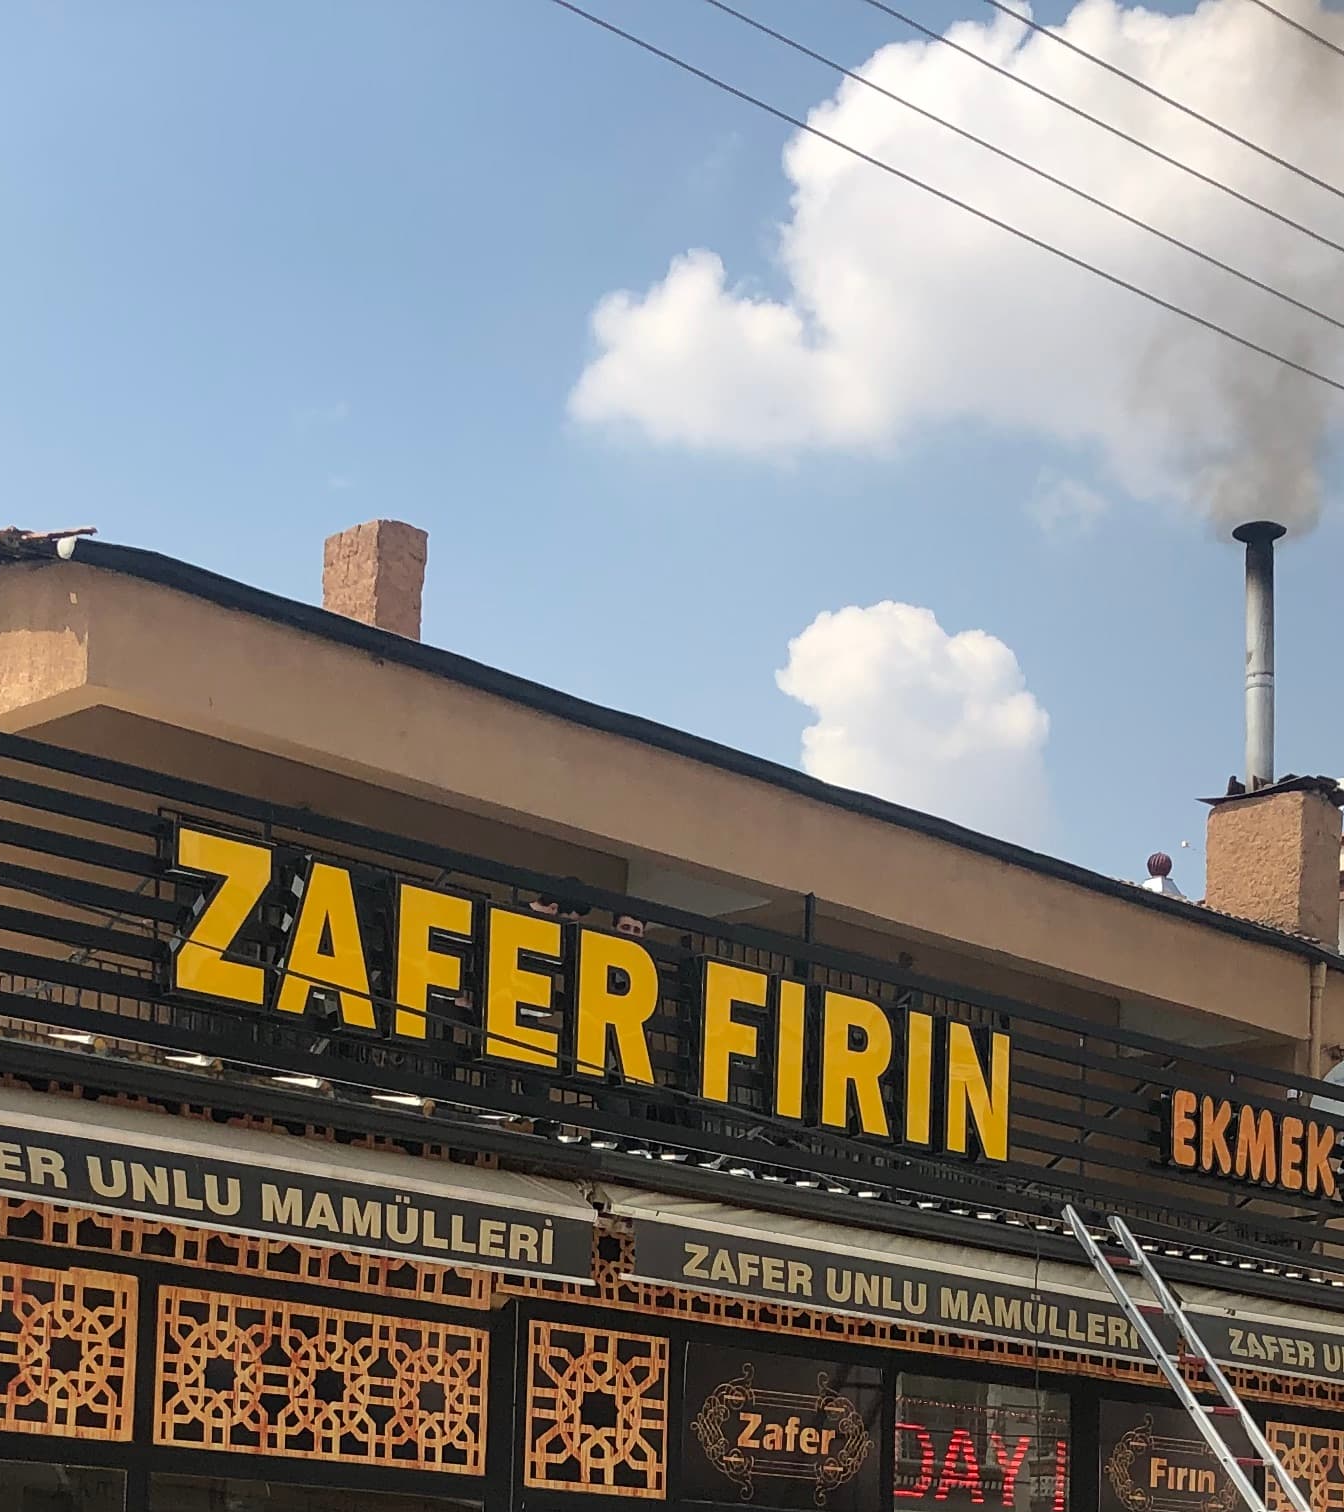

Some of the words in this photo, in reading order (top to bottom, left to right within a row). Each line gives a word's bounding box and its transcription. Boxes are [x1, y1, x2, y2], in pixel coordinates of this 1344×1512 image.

[175, 827, 655, 1086] ZAFER
[702, 960, 1011, 1162] FIRIN
[1172, 1090, 1336, 1198] EKMEK
[87, 1155, 239, 1217] UNLU
[260, 1183, 554, 1265] MAMÜLLERİ
[683, 1243, 813, 1295] ZAFER
[826, 1268, 927, 1315] UNLU
[1228, 1328, 1315, 1368] ZAFER
[737, 1412, 836, 1455] Zafer
[1149, 1458, 1215, 1493] Fırın
